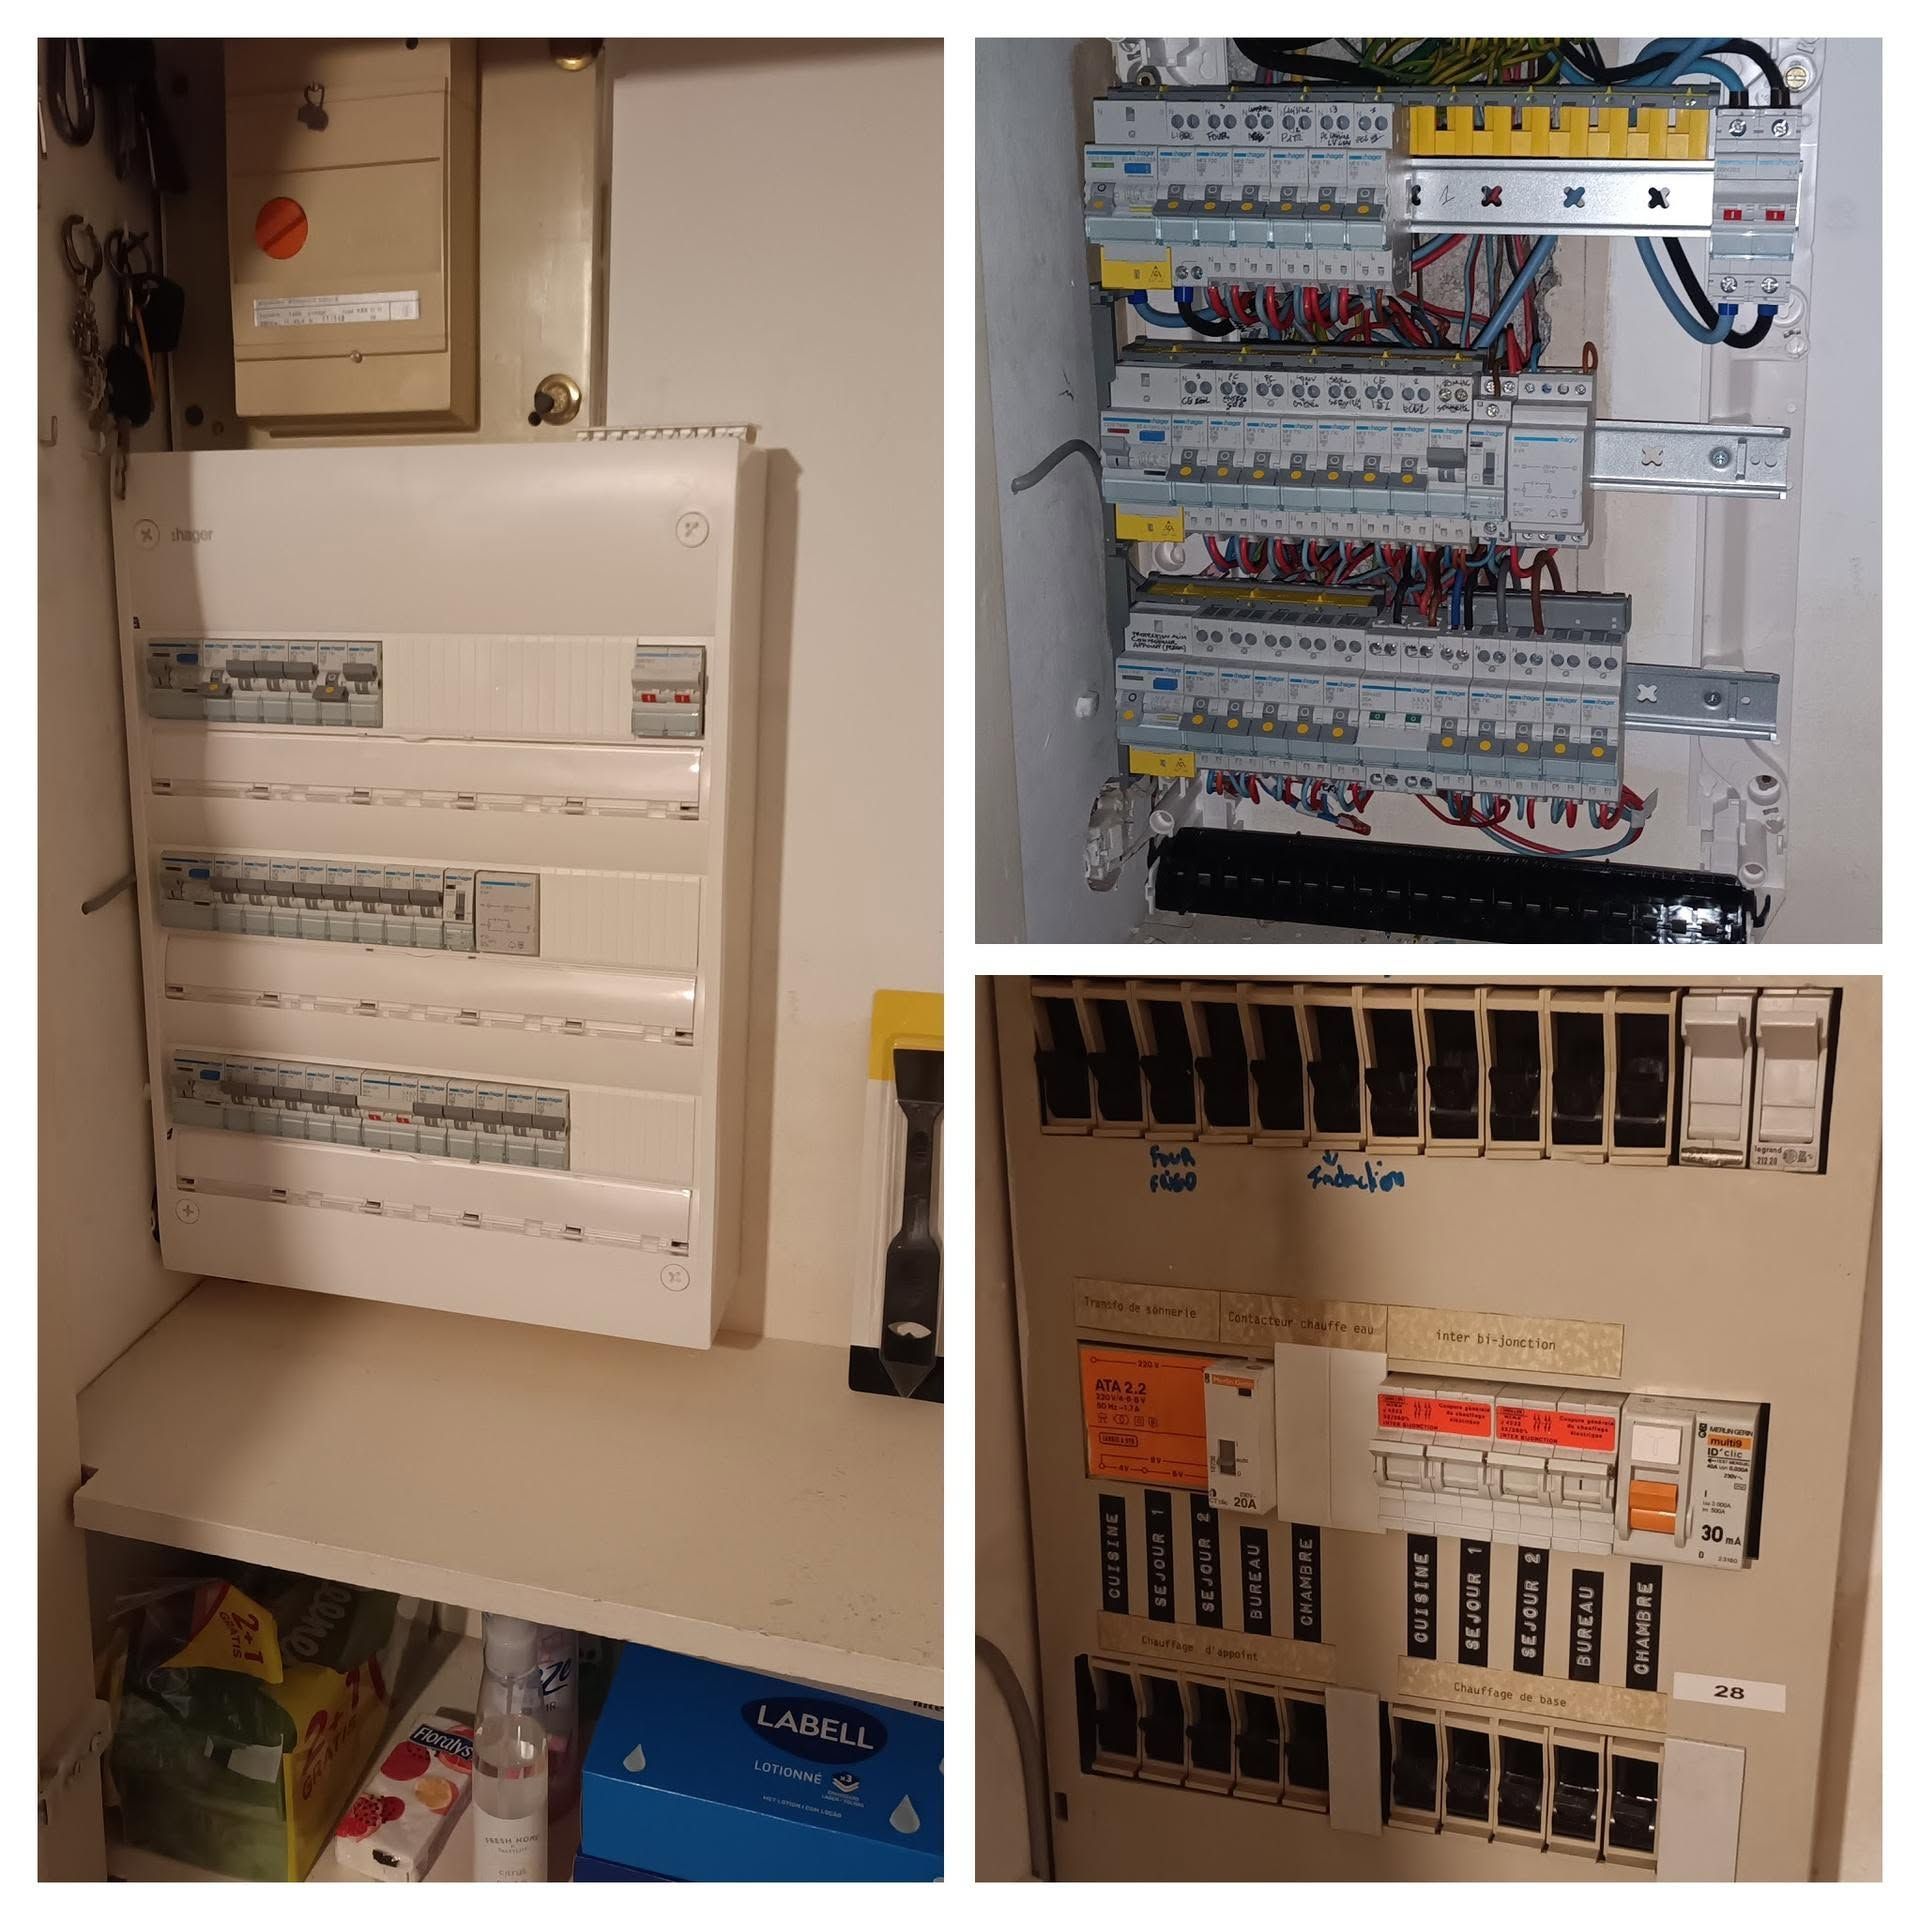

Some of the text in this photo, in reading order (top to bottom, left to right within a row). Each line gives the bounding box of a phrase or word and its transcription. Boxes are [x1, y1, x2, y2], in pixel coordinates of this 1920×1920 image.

[1754, 1145, 1783, 1154] legrand
[1084, 1296, 1198, 1319] Transfo de sonnerie
[1228, 1311, 1375, 1336] Contacteur chauffe eau
[1436, 1329, 1557, 1351] inter bi-jonction
[1096, 1379, 1147, 1395] ATA 2.2
[1710, 1438, 1742, 1448] multi9
[1234, 1497, 1256, 1510] 20A
[1701, 1524, 1742, 1547] 30 mA
[1106, 1513, 1121, 1599] CUISINE
[1152, 1533, 1167, 1608] SEJOUR
[1197, 1512, 1216, 1613] SEJOUR 2
[1247, 1545, 1264, 1620] BUREAU
[1299, 1538, 1313, 1626] CHAMBRE
[1414, 1553, 1430, 1643] CUISINE
[1465, 1546, 1482, 1651] SEJOUR 1
[1521, 1552, 1541, 1659] SEJOUR 2
[231, 1612, 264, 1664] 2+1
[1576, 1586, 1595, 1667] BUREAU
[1634, 1582, 1654, 1675] CHAMBRE
[1141, 1635, 1258, 1662] Chauffage d'appoint
[1454, 1682, 1567, 1708] Chauffage de base
[1714, 1685, 1745, 1700] 28
[413, 1726, 474, 1759] Floralys
[757, 1704, 874, 1750] LABELL
[754, 1760, 822, 1785] LOTIONNÉ
